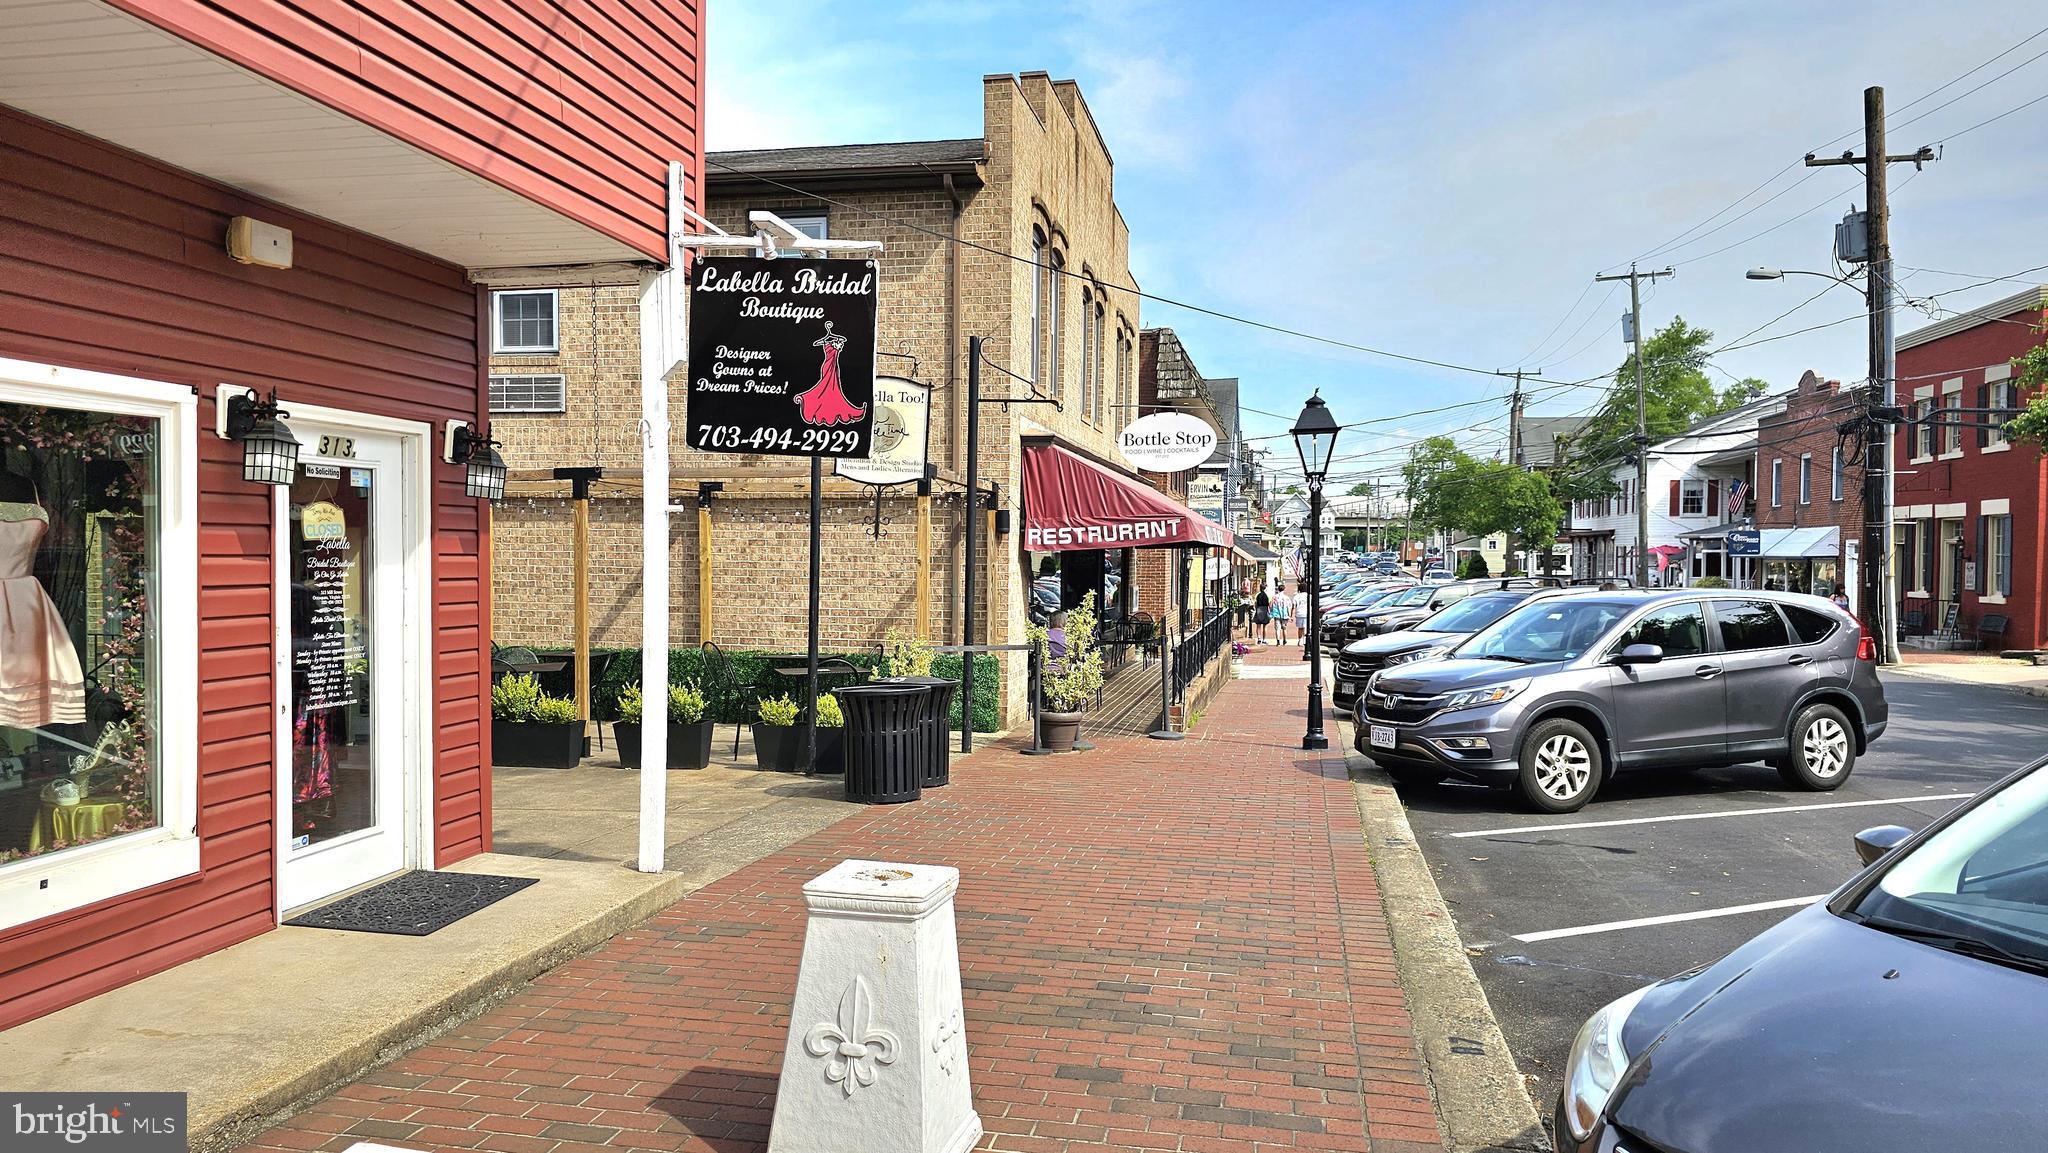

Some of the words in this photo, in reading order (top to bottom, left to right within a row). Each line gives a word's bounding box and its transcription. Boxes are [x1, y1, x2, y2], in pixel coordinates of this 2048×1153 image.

[697, 267, 784, 293] Labella
[791, 268, 871, 295] Bridal
[740, 297, 825, 323] Boutique
[715, 345, 771, 362] Designer
[712, 362, 754, 377] Gowns
[758, 365, 773, 377] at
[696, 378, 740, 393] Dream
[744, 381, 789, 395] Prices!
[898, 391, 925, 404] Too!
[698, 424, 859, 453] 703-494-2929
[1124, 432, 1171, 446] Bottle
[1176, 431, 1211, 447] Stop
[306, 466, 314, 474] No
[315, 467, 340, 479] Soliciting
[1190, 484, 1208, 493] ERVIN
[306, 524, 343, 537] CLOSED
[1028, 518, 1181, 545] RESTAURANT
[316, 532, 351, 554] Labella
[307, 557, 329, 568] Bridal
[330, 557, 356, 570] Boutique
